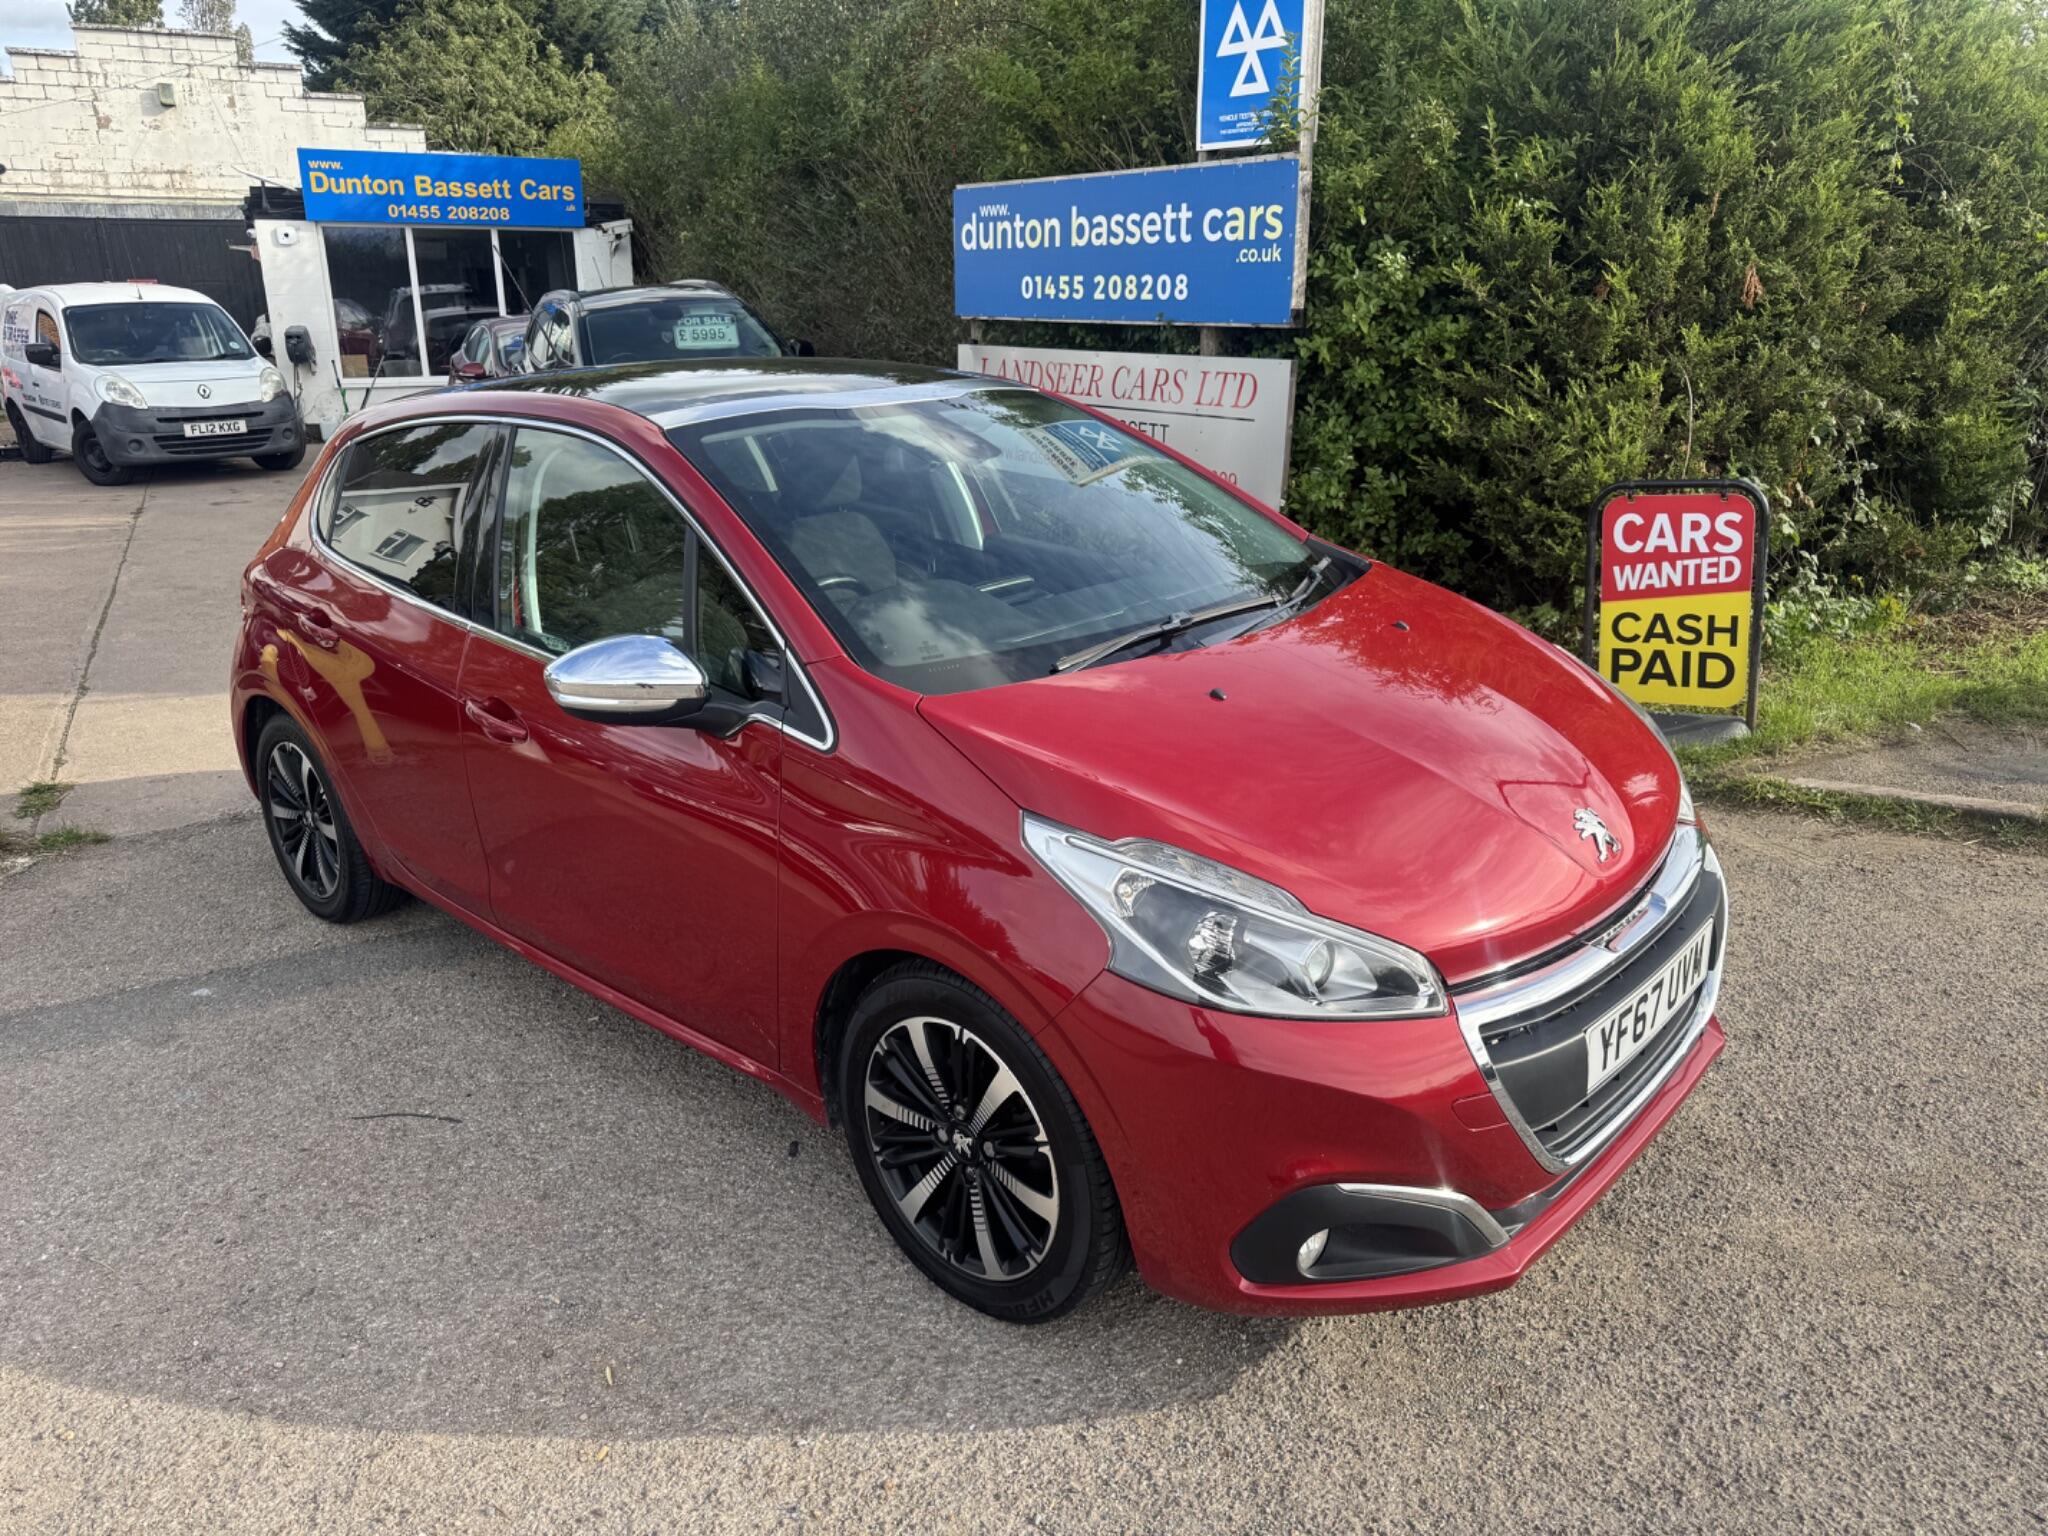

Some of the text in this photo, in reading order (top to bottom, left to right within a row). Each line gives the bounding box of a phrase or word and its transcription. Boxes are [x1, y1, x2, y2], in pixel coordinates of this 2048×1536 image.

[308, 160, 343, 170] www.
[309, 172, 576, 202] Dunton Bassett Cars
[388, 204, 510, 220] 01455 208208
[979, 203, 1010, 217] www.
[961, 203, 1284, 250] dunton bassett cars
[1235, 243, 1282, 263] .co.uk
[1021, 273, 1189, 300] 01455 208208
[677, 316, 732, 326] FOR SALE
[692, 328, 725, 340] 5995
[1111, 365, 1189, 405] CARS
[1193, 370, 1259, 409] LTD
[190, 421, 241, 435] FL12 KXG
[1612, 512, 1743, 553] CARS
[1613, 555, 1742, 591] WANTED
[1611, 612, 1739, 647] CASH
[1610, 648, 1736, 689] PAID
[1600, 978, 1665, 1072] YF67
